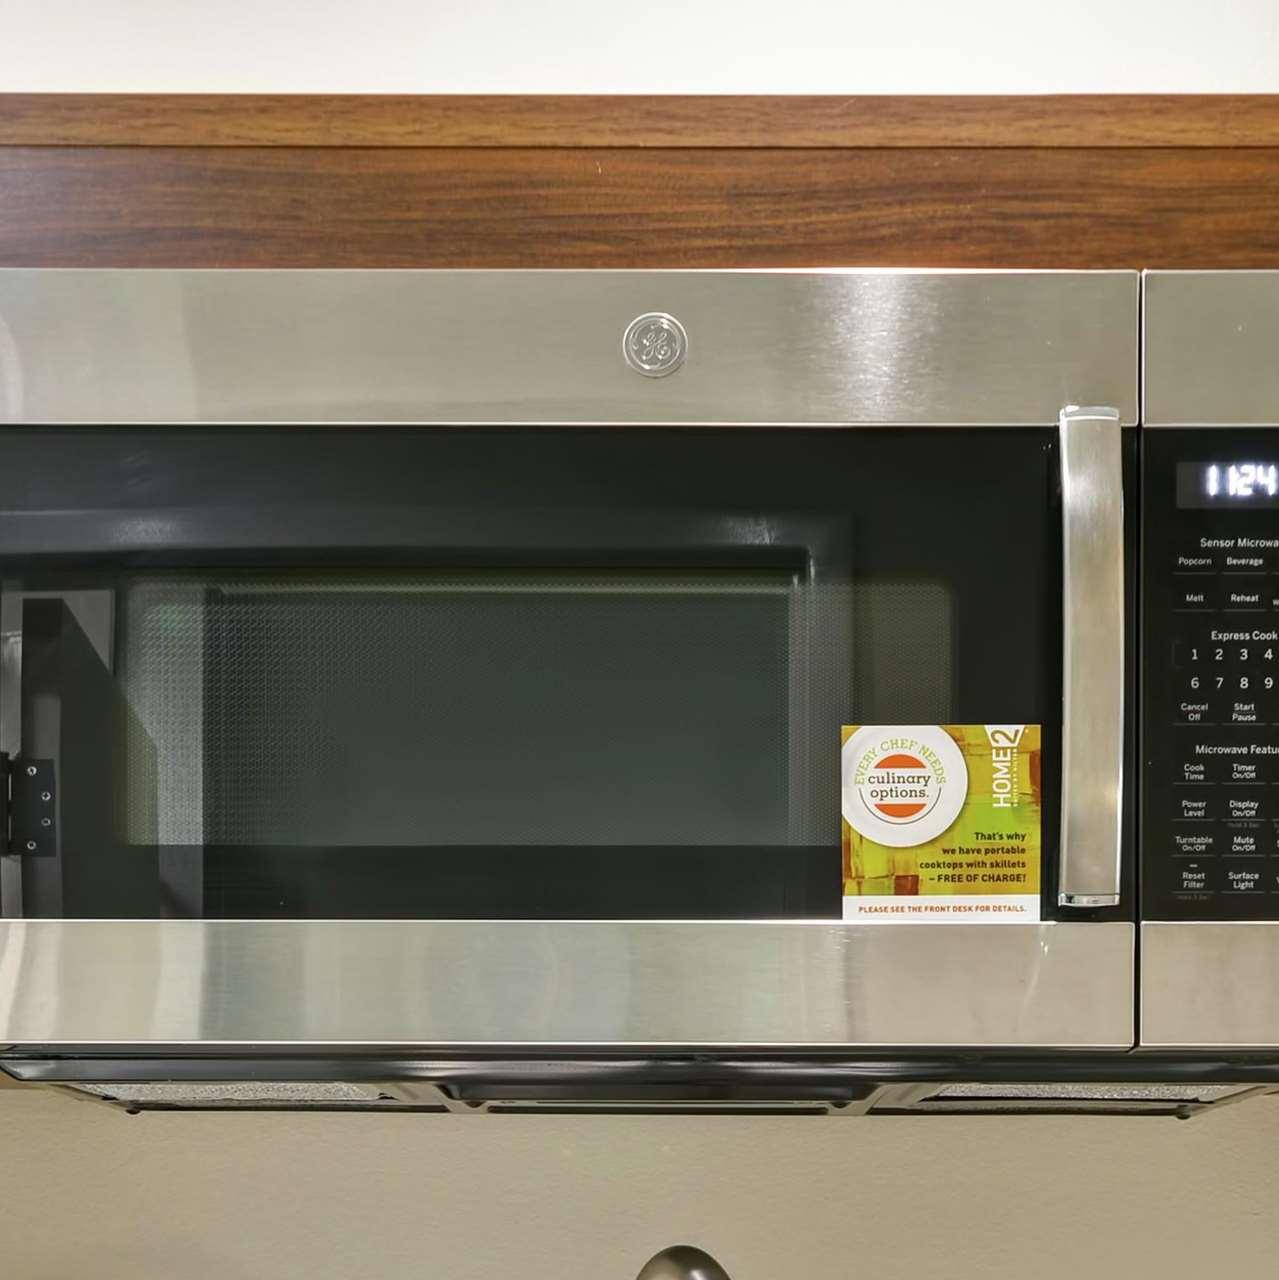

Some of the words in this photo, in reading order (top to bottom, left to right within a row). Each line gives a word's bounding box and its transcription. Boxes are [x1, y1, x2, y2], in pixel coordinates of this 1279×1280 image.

[1200, 537, 1235, 548] Sensor
[1178, 557, 1212, 567] Popcorn
[1226, 557, 1263, 567] Beverage
[1230, 594, 1259, 602] Reheat
[1211, 631, 1250, 643] Express
[1252, 631, 1278, 641] Cook
[1192, 649, 1198, 660] 1
[1215, 649, 1223, 660] 2
[1239, 649, 1248, 660] 3
[1264, 649, 1273, 660] 4
[1190, 677, 1200, 689] 6
[1216, 677, 1224, 689] 7
[1239, 677, 1249, 689] 8
[1264, 677, 1273, 689] 9
[1180, 703, 1209, 711] Cancel
[1233, 703, 1255, 711] Start
[1188, 713, 1201, 721] Off
[1232, 713, 1257, 721] Pause
[1195, 744, 1248, 754] Microwave
[854, 747, 878, 785] EVERY
[880, 738, 917, 752] CHEF
[919, 745, 947, 785] NEEDS
[1184, 764, 1205, 772] Cook
[867, 772, 931, 787] culinary
[1184, 773, 1204, 781] Time
[870, 787, 930, 801] options.
[1182, 800, 1207, 808] Power
[1229, 800, 1258, 810] Display
[1184, 809, 1205, 817] Level
[974, 831, 1003, 841] That's
[1006, 832, 1027, 842] why
[1175, 836, 1213, 844] Turntable
[1233, 836, 1255, 844] Mute
[942, 847, 956, 855] we
[959, 846, 981, 855] have
[984, 846, 1026, 857] portable
[919, 860, 963, 871] cooktops
[966, 860, 987, 869] with
[989, 860, 1026, 869] skillets
[937, 873, 963, 883] FREE
[966, 873, 979, 882] OF
[981, 873, 1027, 882] CHARGE!
[1182, 872, 1205, 880] Reset
[1228, 872, 1260, 880] Surface
[1233, 881, 1254, 890] Light
[858, 906, 889, 914] PLEASE
[891, 906, 906, 914] SEE
[908, 906, 922, 914] THE
[924, 905, 951, 913] FRONT
[953, 905, 973, 913] DESK
[975, 905, 991, 913] FOR
